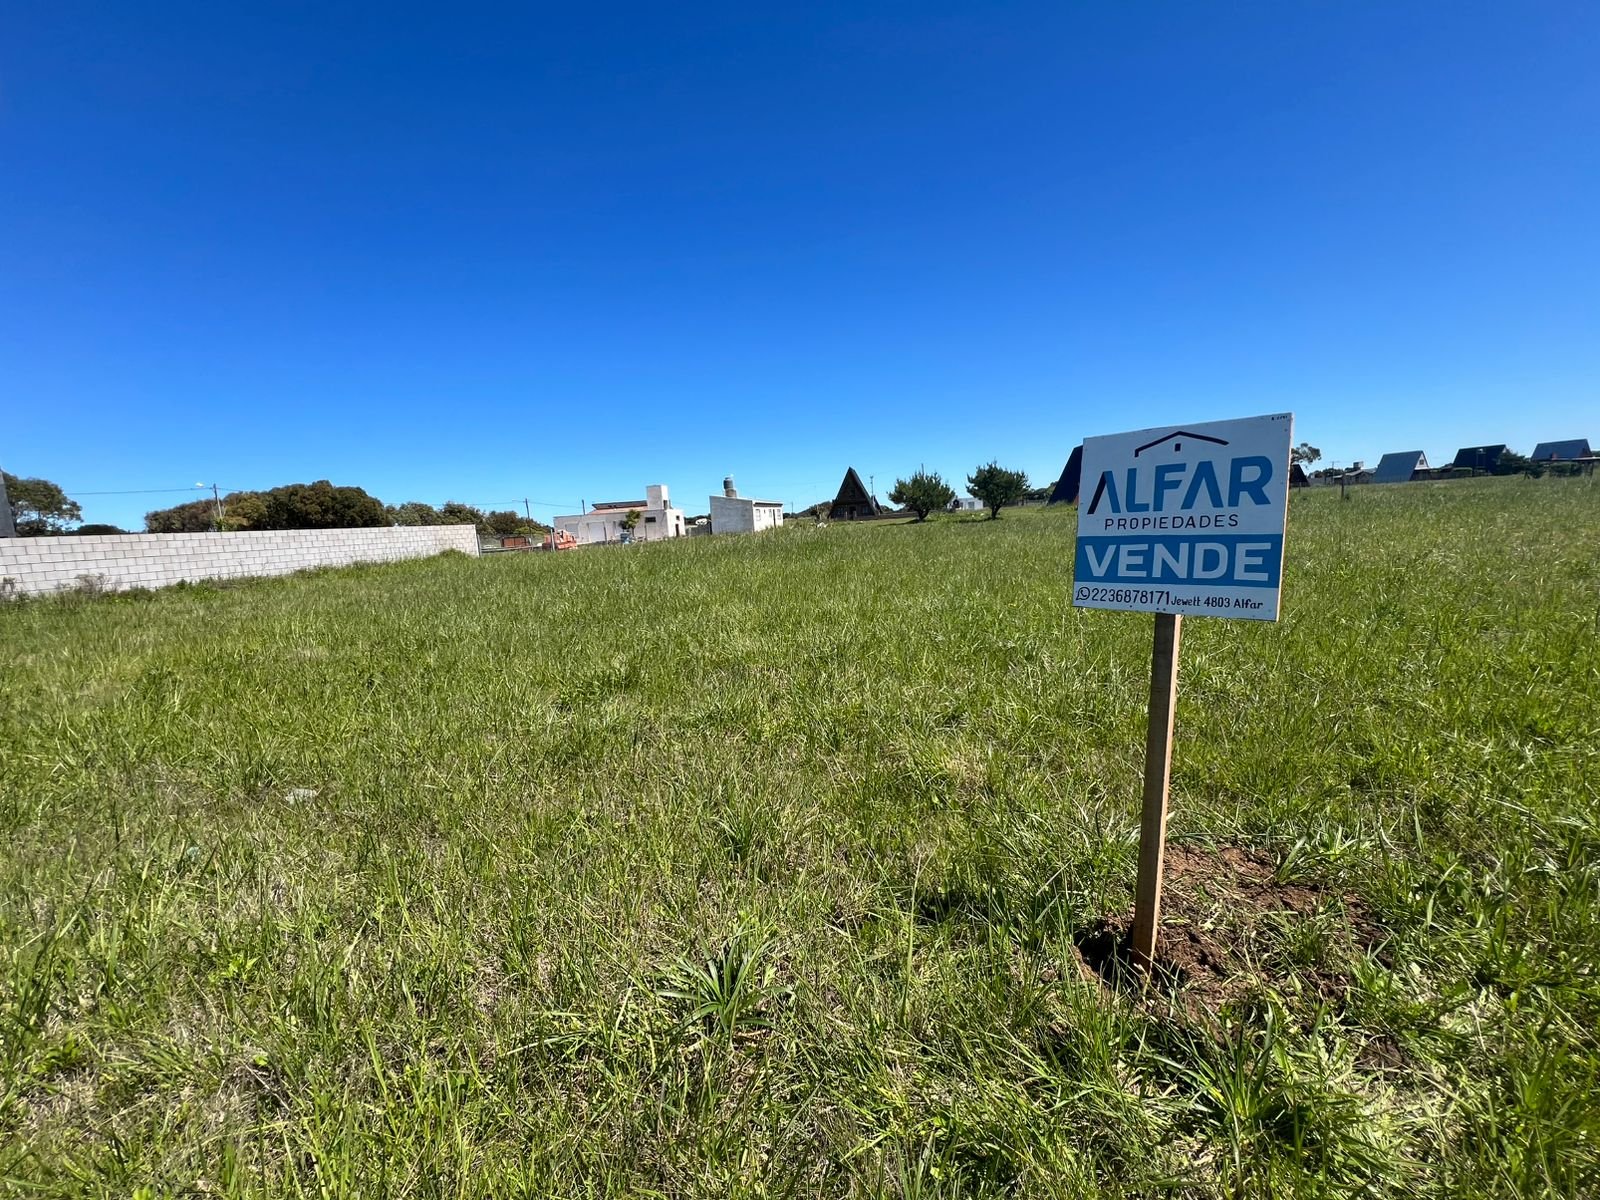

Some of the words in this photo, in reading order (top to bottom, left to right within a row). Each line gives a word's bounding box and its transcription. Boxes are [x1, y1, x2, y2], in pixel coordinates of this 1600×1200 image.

[1087, 456, 1273, 514] ALFAR
[1105, 514, 1239, 530] PROPIEDADES
[1085, 542, 1272, 582] VENDE
[1091, 588, 1170, 605] 2236878171
[1171, 596, 1201, 607] Jewett
[1203, 596, 1231, 608] 4803
[1233, 598, 1264, 609] Alfar
